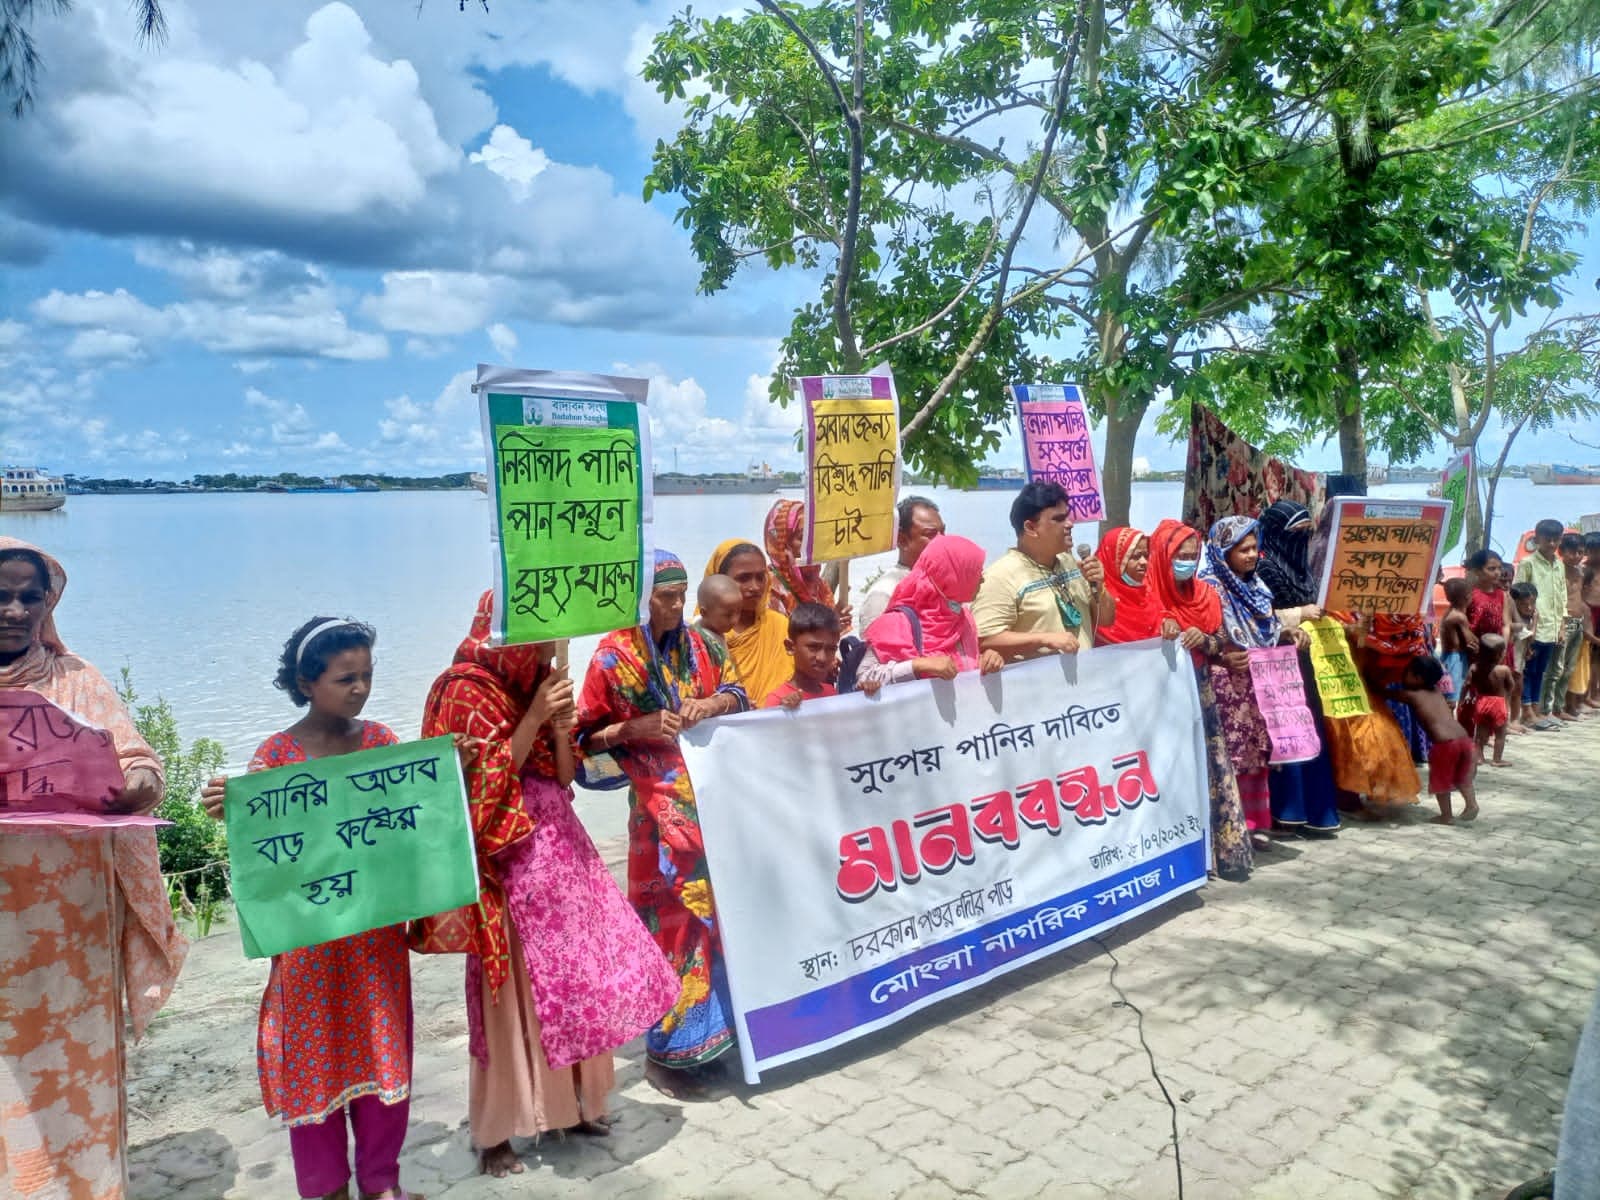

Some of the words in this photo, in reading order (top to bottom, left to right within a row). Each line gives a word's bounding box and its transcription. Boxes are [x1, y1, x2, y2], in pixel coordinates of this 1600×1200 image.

[499, 431, 572, 487] নিরাপদ
[578, 439, 636, 486] পানি
[859, 448, 897, 491] পানি
[506, 502, 555, 540] পান
[557, 499, 633, 541] করুন
[833, 506, 873, 546] চাই
[575, 559, 639, 614] থাকুন
[845, 745, 944, 794] সুপেয়
[956, 723, 1035, 762] পানির
[1042, 702, 1121, 741] দাবিতে
[247, 773, 329, 820] পানির
[346, 757, 441, 795] অভাব
[252, 832, 304, 865] বড়
[336, 804, 423, 849] কষ্টের
[836, 750, 1159, 904] মানববন্ধন
[301, 870, 360, 905] হয়
[799, 950, 839, 981] স্থান:
[955, 888, 985, 920] নদীর
[870, 944, 976, 1004] মোংলা
[982, 898, 1089, 954] নাগরিক
[1093, 868, 1163, 908] সমাজ
